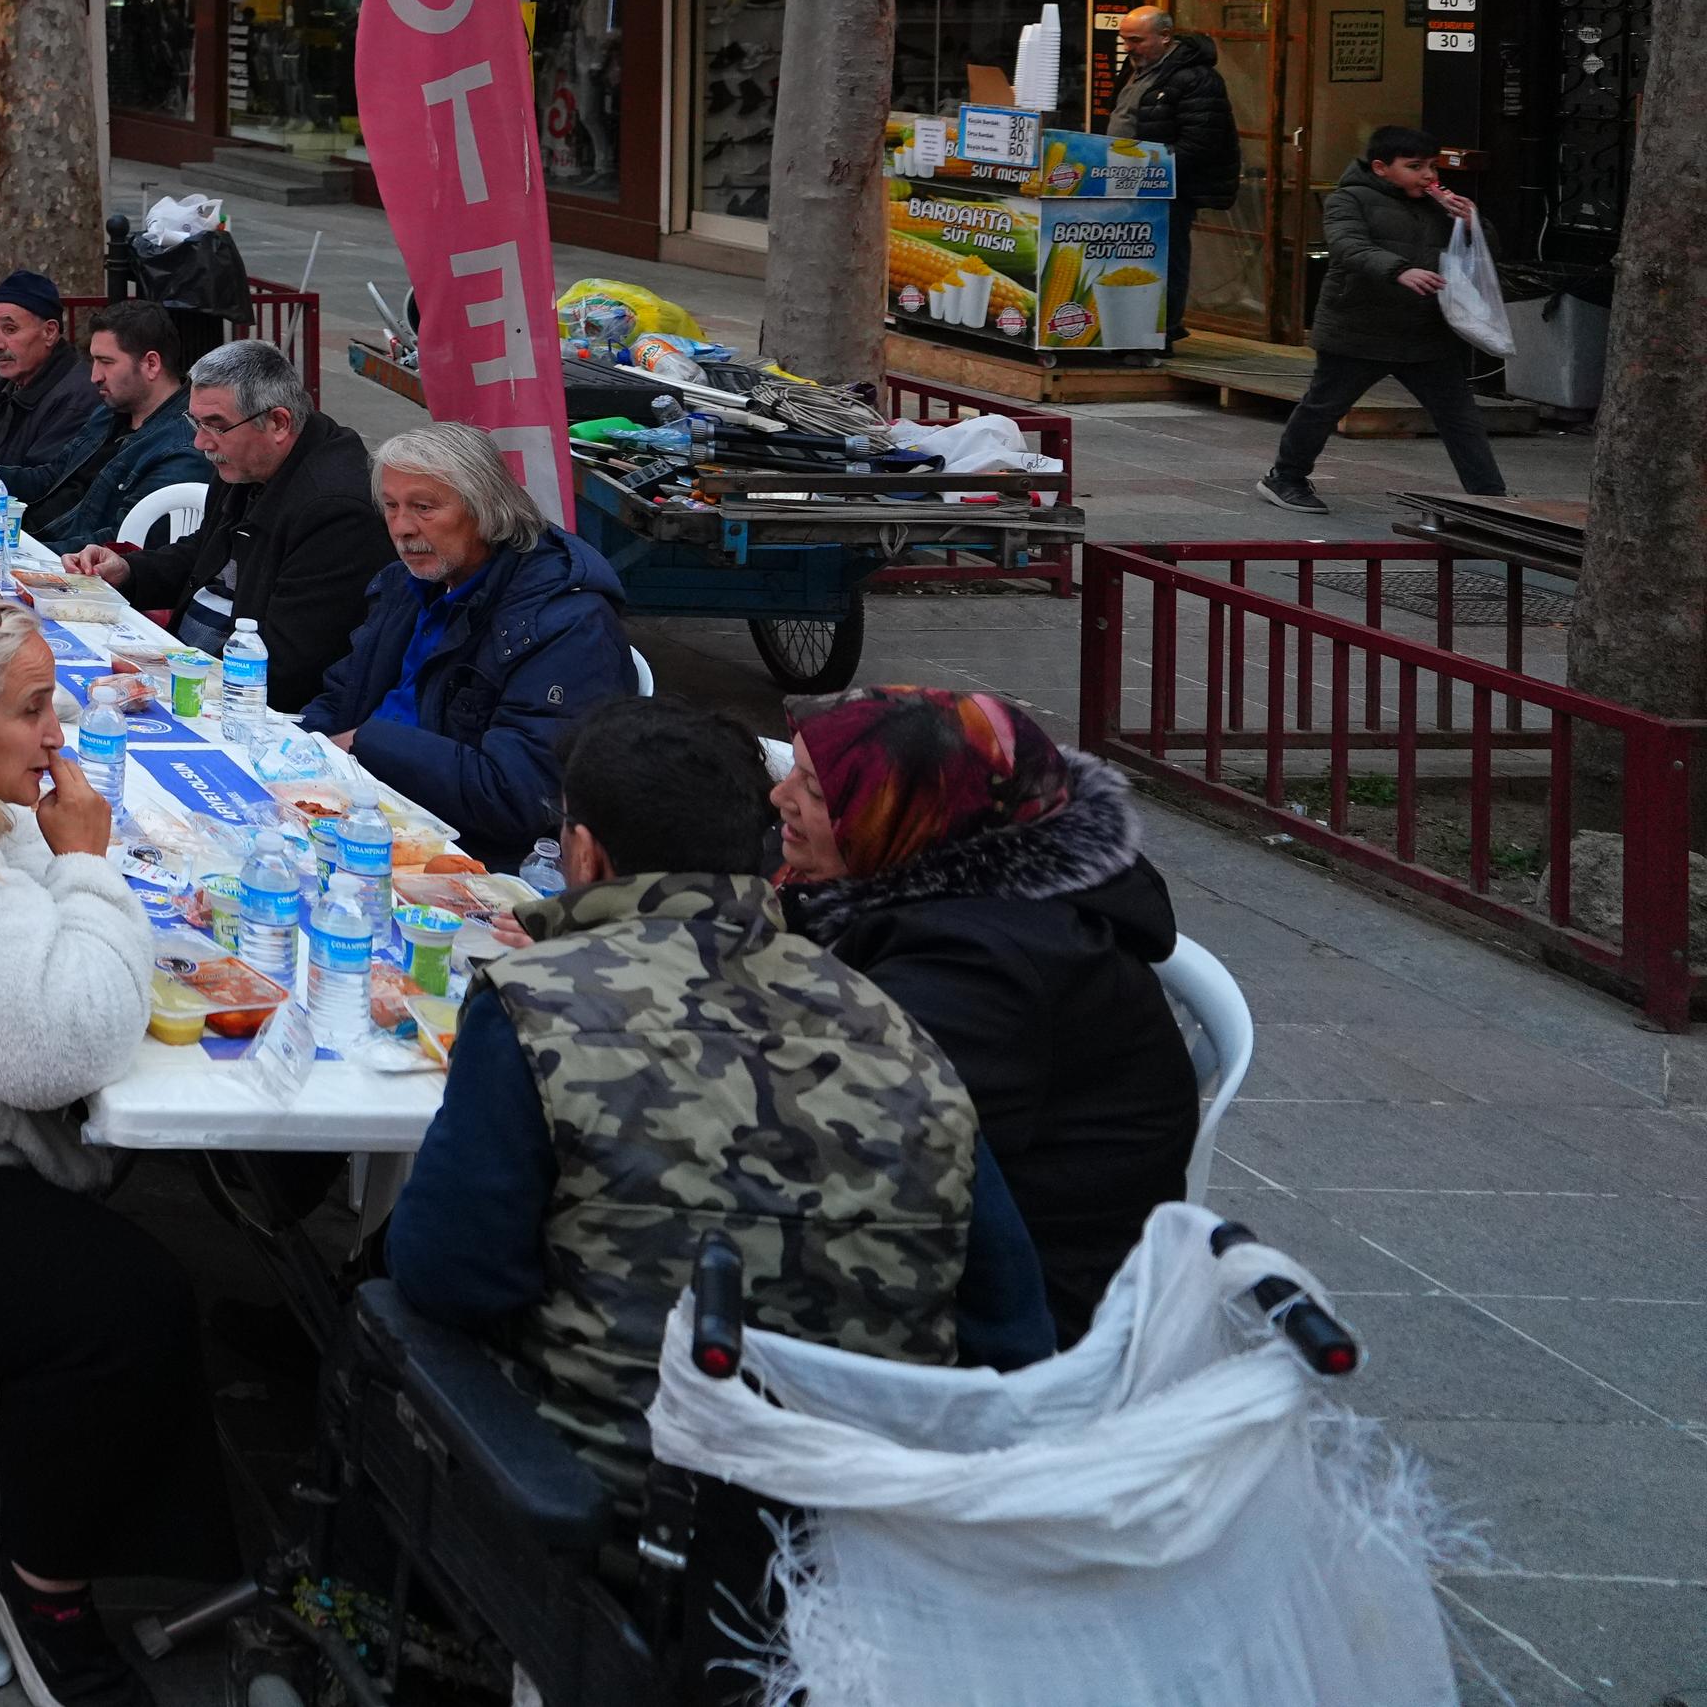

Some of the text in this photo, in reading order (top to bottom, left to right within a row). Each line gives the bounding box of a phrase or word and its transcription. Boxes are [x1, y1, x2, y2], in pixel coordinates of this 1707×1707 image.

[1104, 15, 1119, 28] 75
[1440, 34, 1458, 48] 30
[1009, 116, 1025, 130] 30
[1009, 129, 1024, 143] 40
[997, 167, 1030, 183] MISIR
[1090, 166, 1167, 179] BARDAKTA
[1139, 178, 1169, 190] MISIR
[908, 197, 1013, 234] BARDAKTA
[942, 226, 1017, 253] SÜT MISIR
[1052, 223, 1153, 242] BARDAKTA
[1085, 242, 1156, 259] SÜT MISIR
[170, 762, 209, 796] OLSUN
